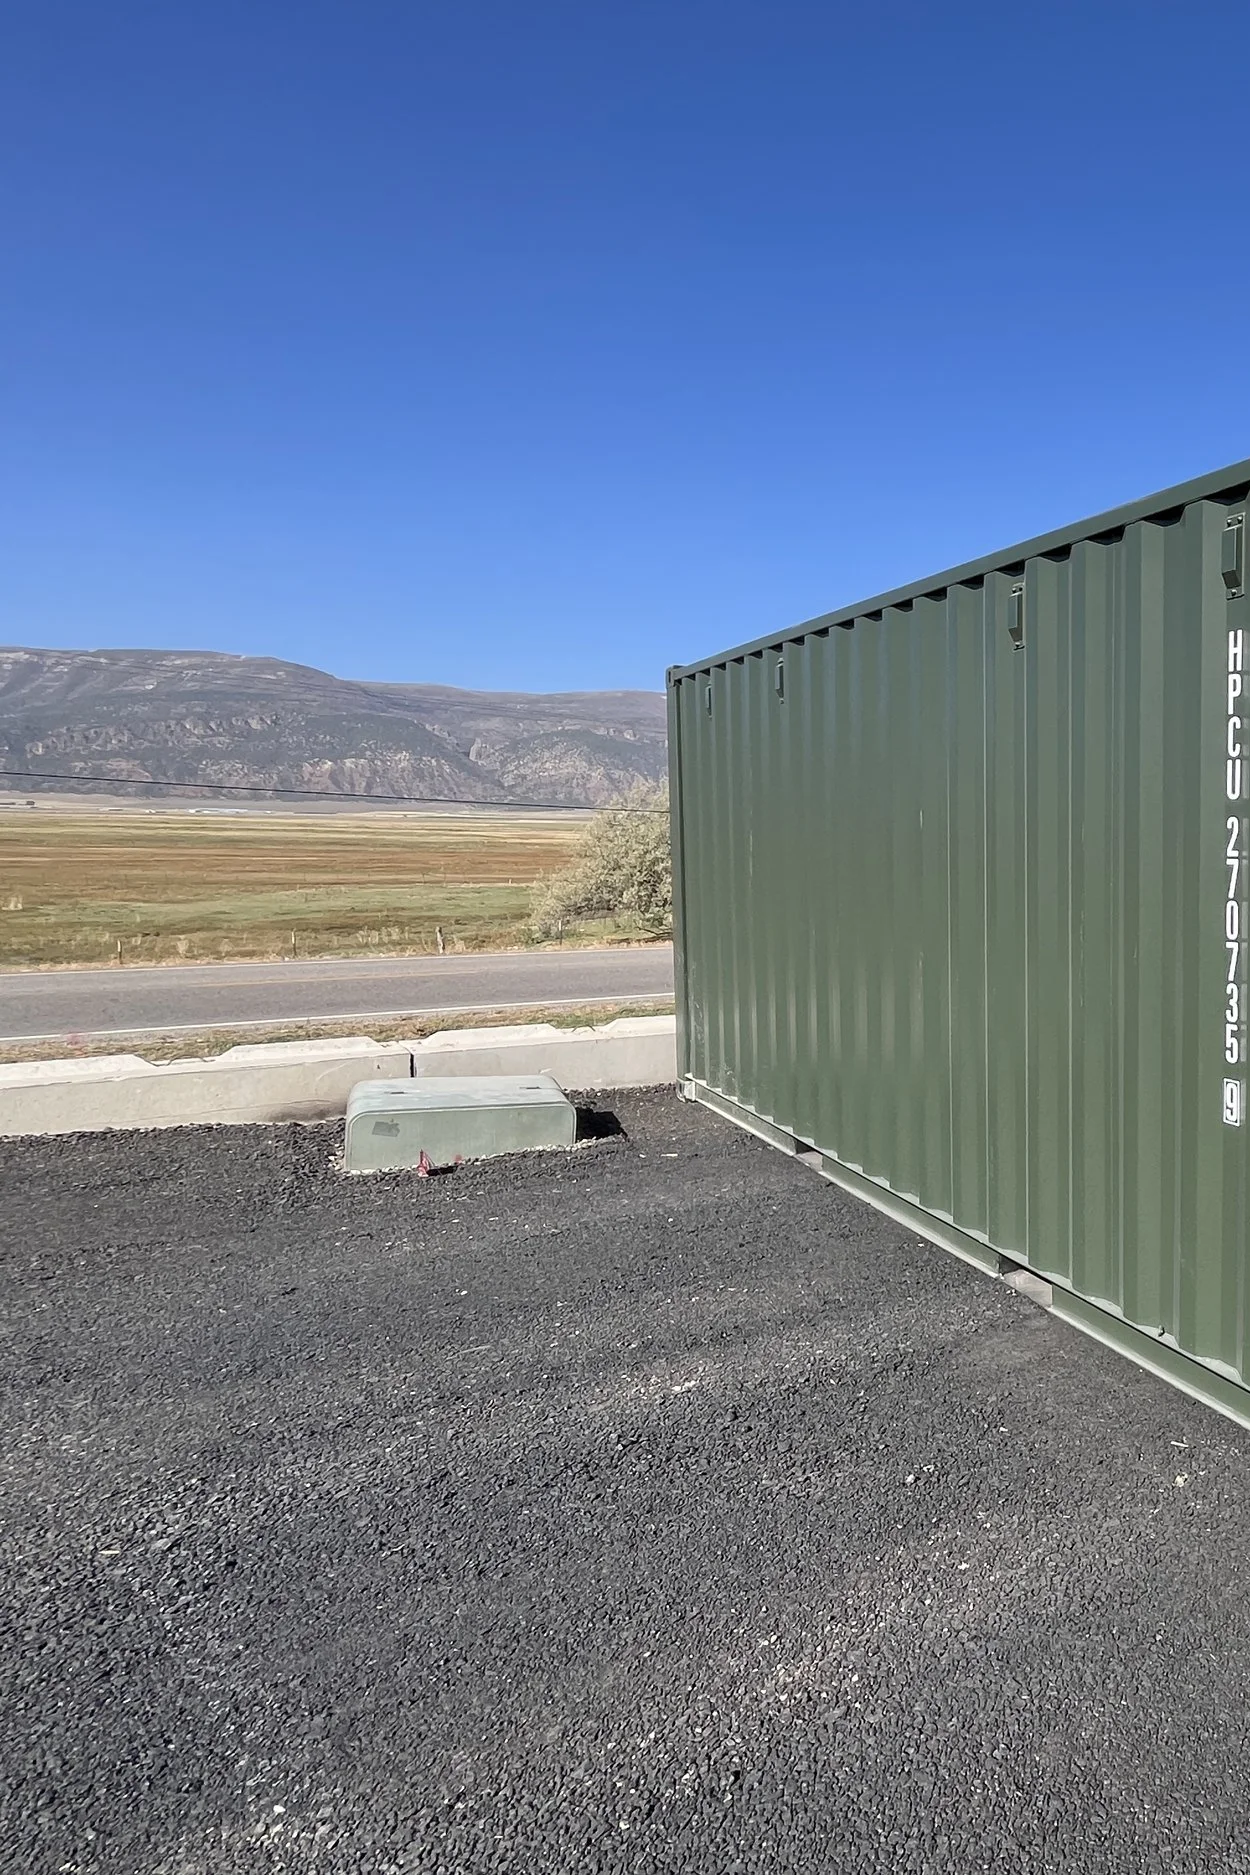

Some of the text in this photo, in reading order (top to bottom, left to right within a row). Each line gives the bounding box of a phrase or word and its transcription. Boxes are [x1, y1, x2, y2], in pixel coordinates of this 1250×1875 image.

[1224, 629, 1243, 1125] HPCU 270735 9
